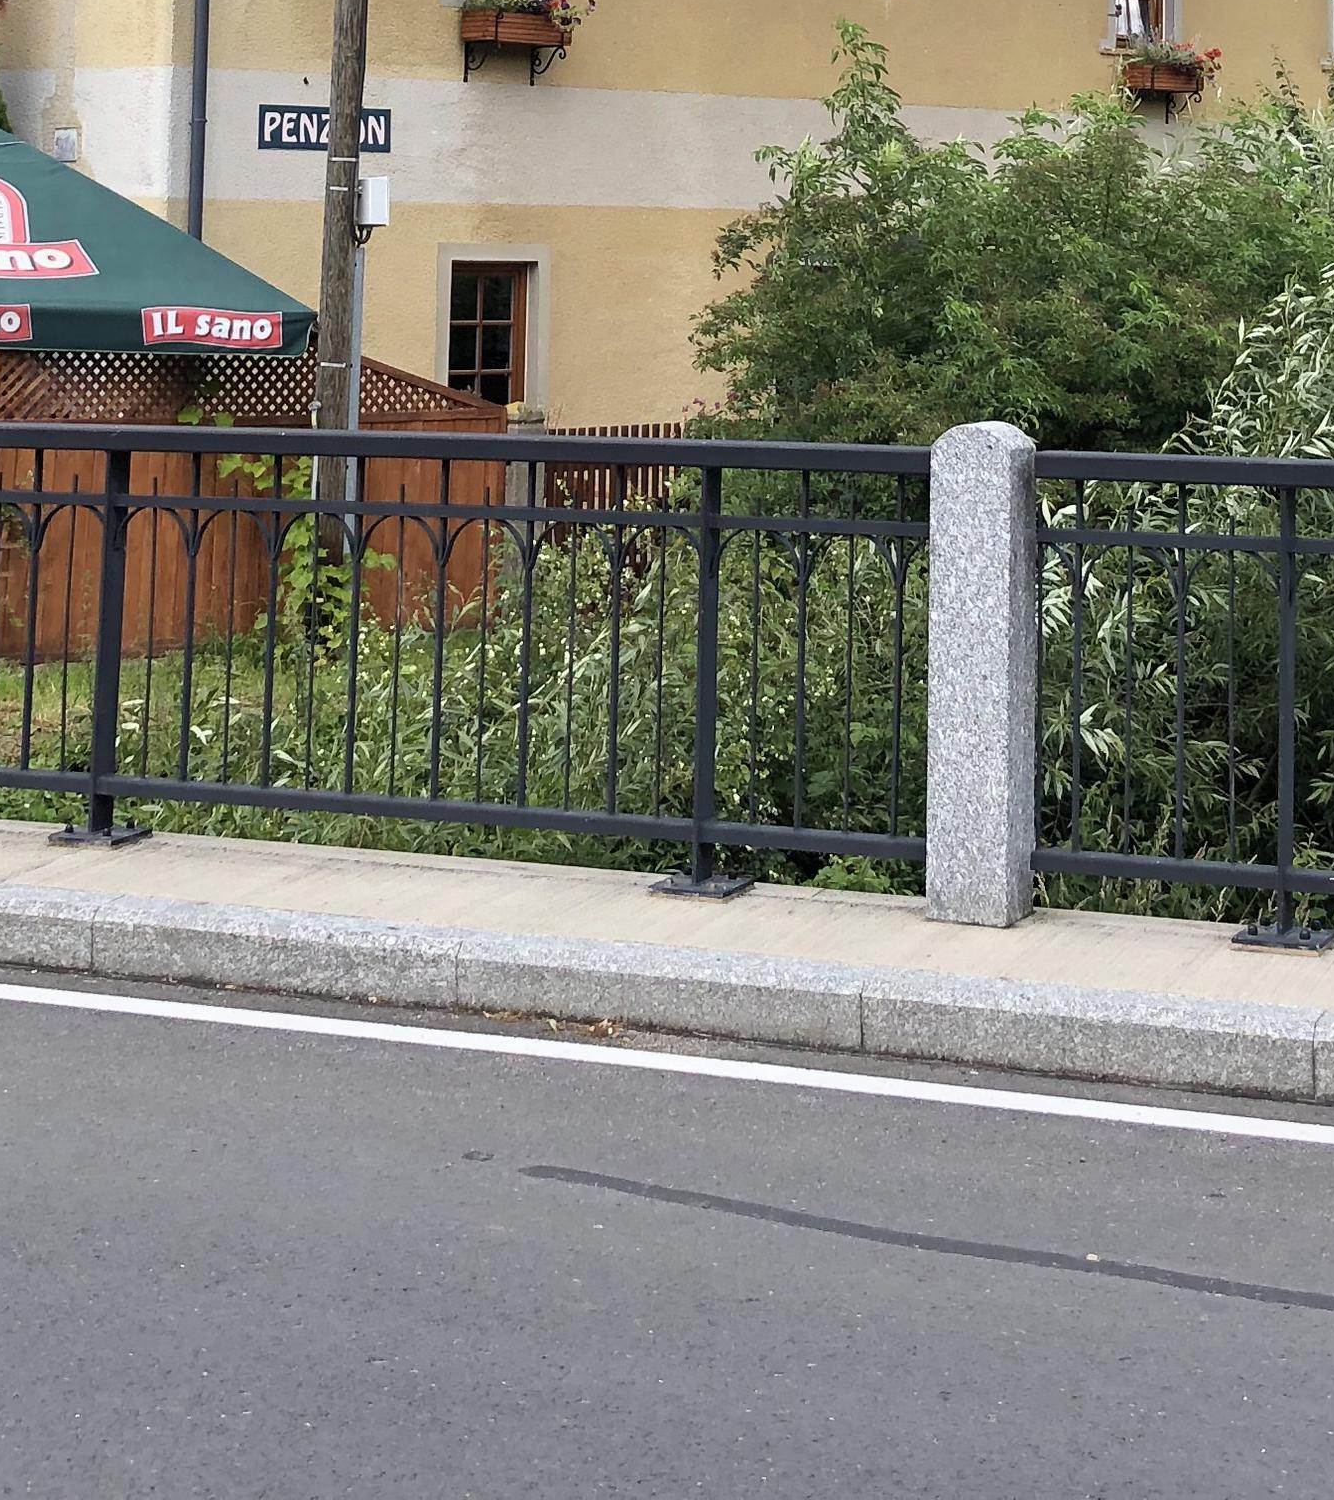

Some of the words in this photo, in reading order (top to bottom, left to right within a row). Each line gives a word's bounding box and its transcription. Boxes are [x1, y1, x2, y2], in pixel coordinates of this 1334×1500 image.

[263, 111, 386, 146] PENZN
[151, 310, 184, 337] IL
[194, 313, 273, 341] sano
